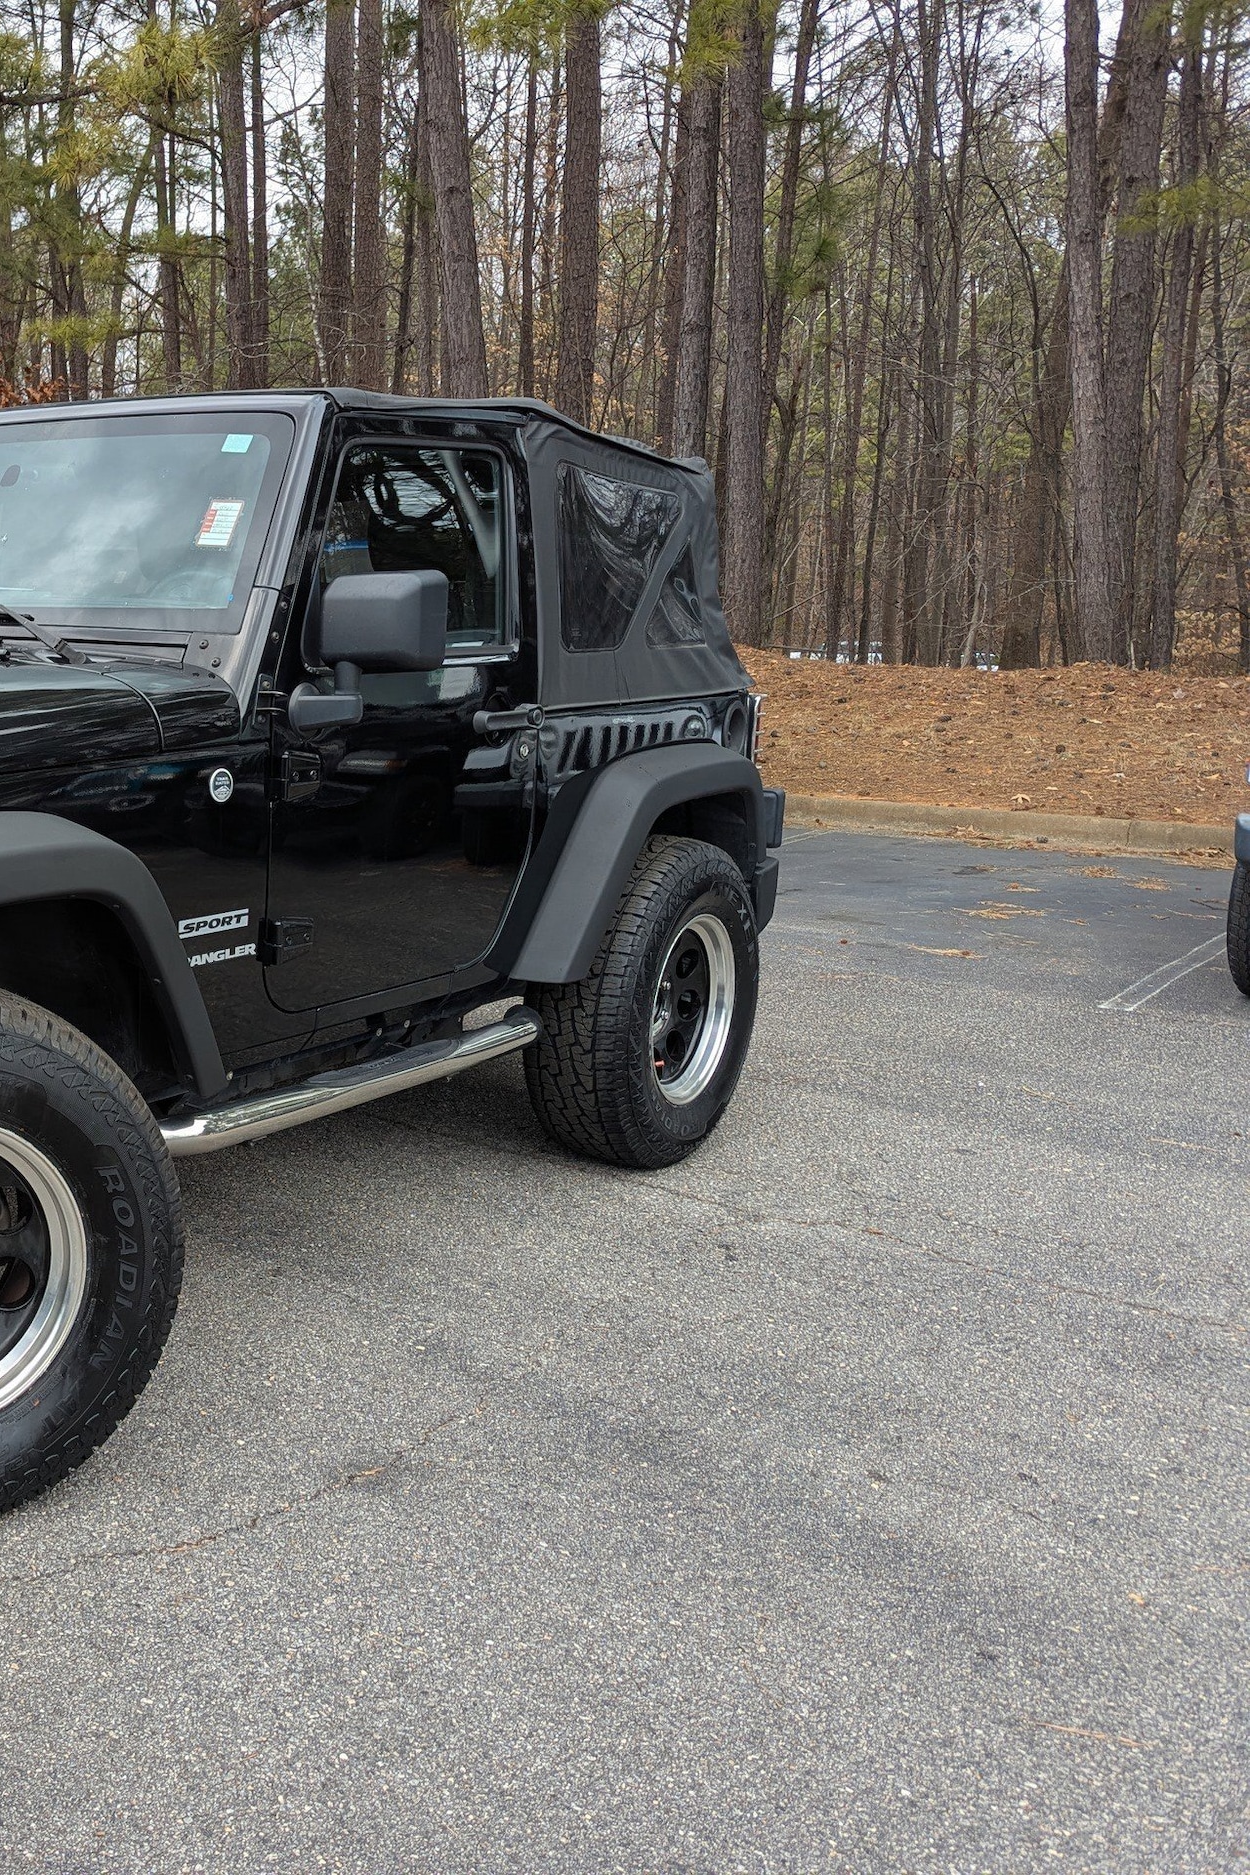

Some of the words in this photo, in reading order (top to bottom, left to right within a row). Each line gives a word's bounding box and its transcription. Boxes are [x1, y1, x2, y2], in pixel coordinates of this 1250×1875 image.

[181, 912, 248, 934] SPORT
[187, 942, 257, 968] ANGLER
[88, 1164, 138, 1373] ROADIAN
